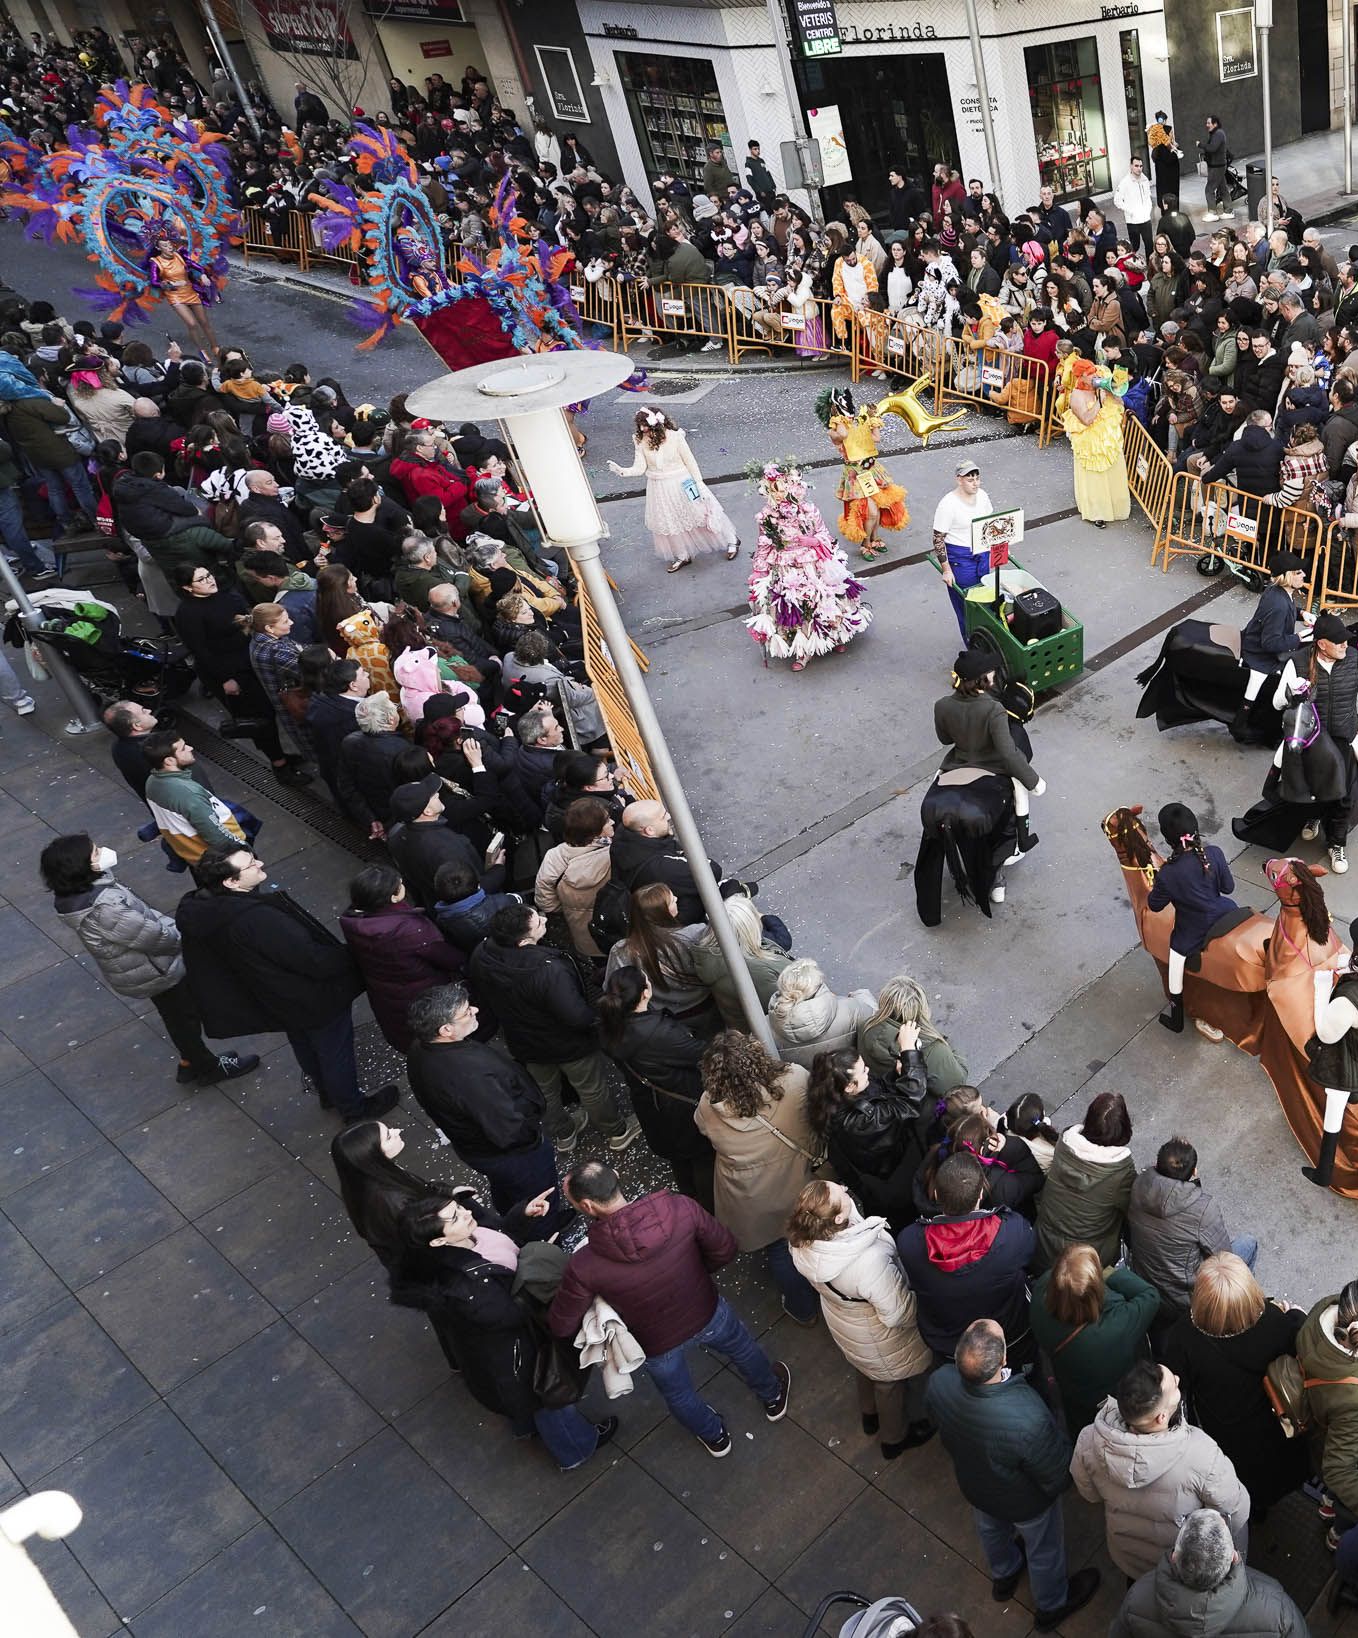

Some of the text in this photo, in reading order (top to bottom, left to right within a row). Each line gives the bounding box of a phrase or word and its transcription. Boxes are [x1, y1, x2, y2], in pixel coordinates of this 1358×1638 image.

[1101, 2, 1139, 18] Herbario
[799, 12, 833, 28] VETERIS
[806, 28, 834, 39] CENTRO
[838, 22, 938, 41] Florinda
[804, 37, 841, 56] LIBRE
[1223, 61, 1252, 73] Florinda
[960, 97, 998, 105] CONSTA
